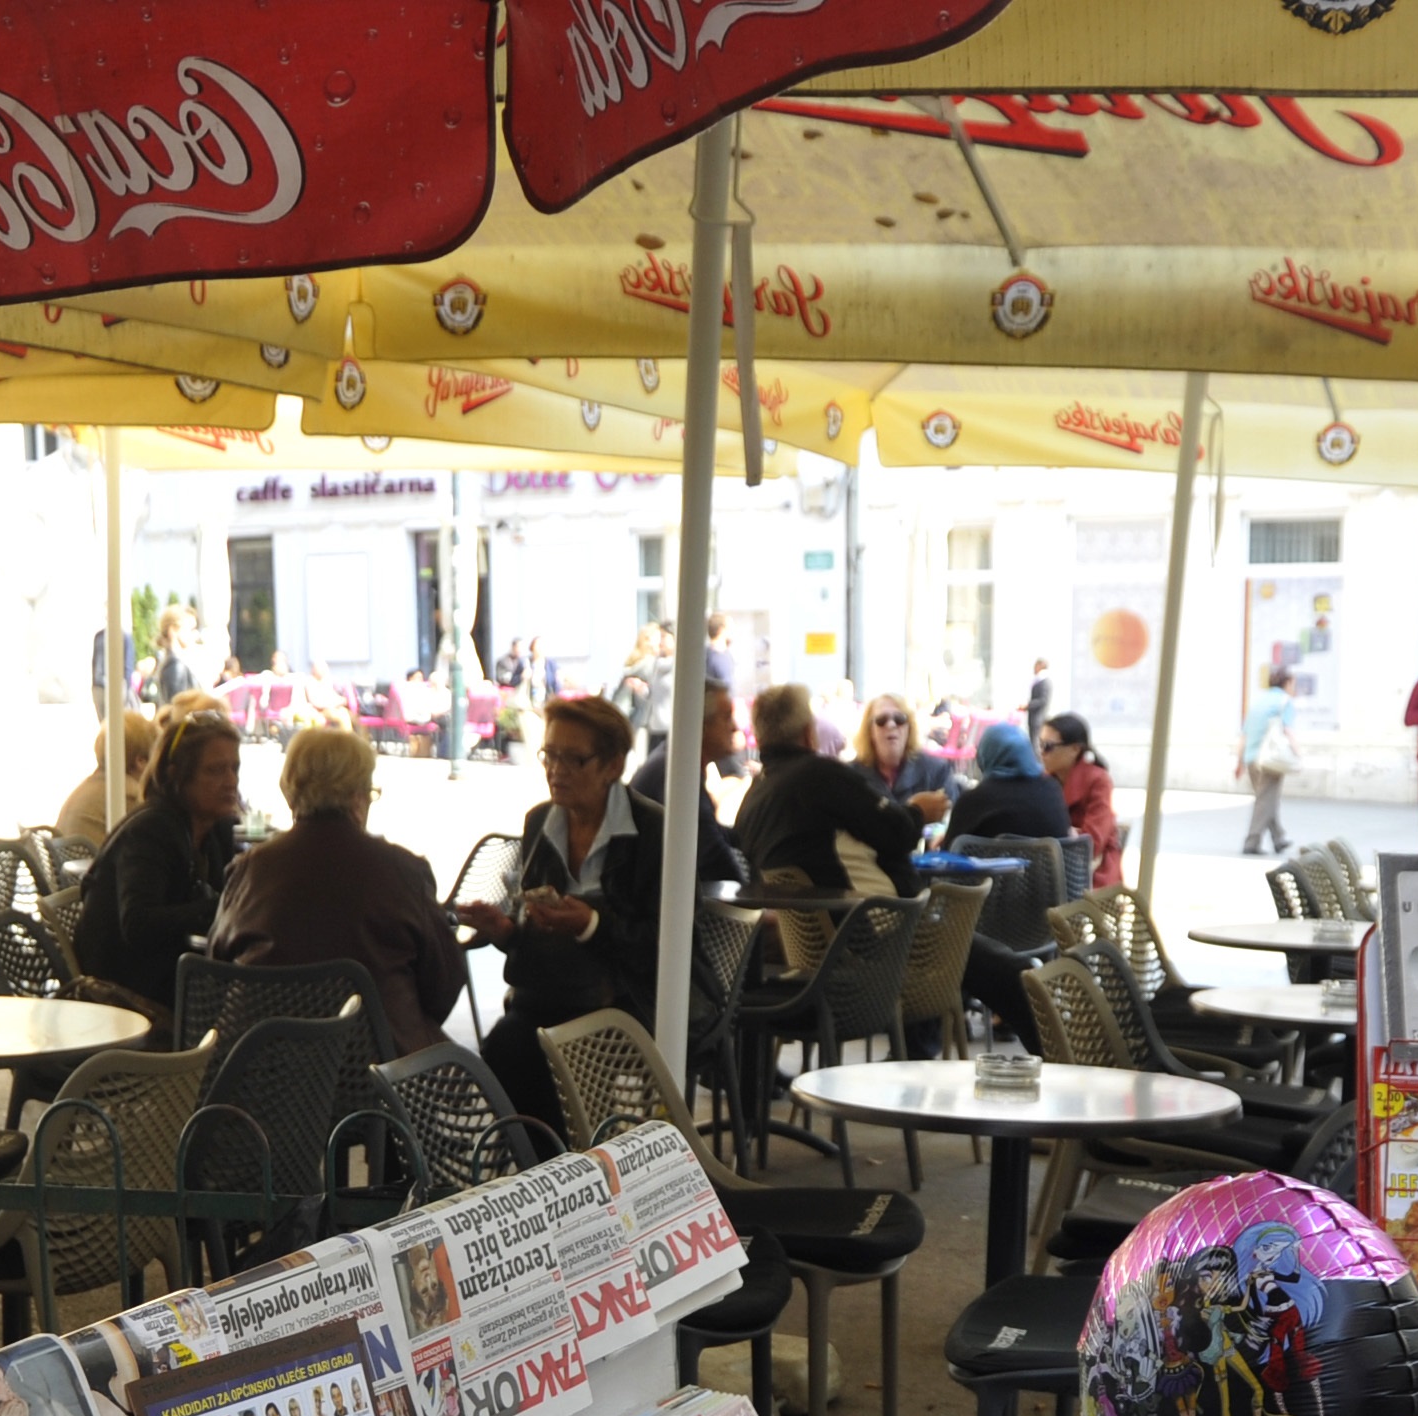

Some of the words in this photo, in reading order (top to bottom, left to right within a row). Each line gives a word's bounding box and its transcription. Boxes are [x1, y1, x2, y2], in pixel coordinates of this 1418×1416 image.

[236, 481, 292, 501] caffe
[310, 474, 435, 500] slastičarna
[1402, 902, 1412, 913] U
[500, 1213, 547, 1247] mora
[463, 1233, 502, 1273] biti
[301, 1271, 347, 1306] trajno
[348, 1262, 373, 1293] Mir
[458, 1242, 557, 1301] Terorizam
[219, 1285, 299, 1339] opredjelje
[518, 1310, 548, 1336] gasovod
[507, 1328, 518, 1340] od
[216, 1392, 231, 1405] ZA
[277, 1364, 308, 1387] VIJEĆE
[307, 1360, 330, 1377] STARI
[331, 1351, 354, 1369] GRAD
